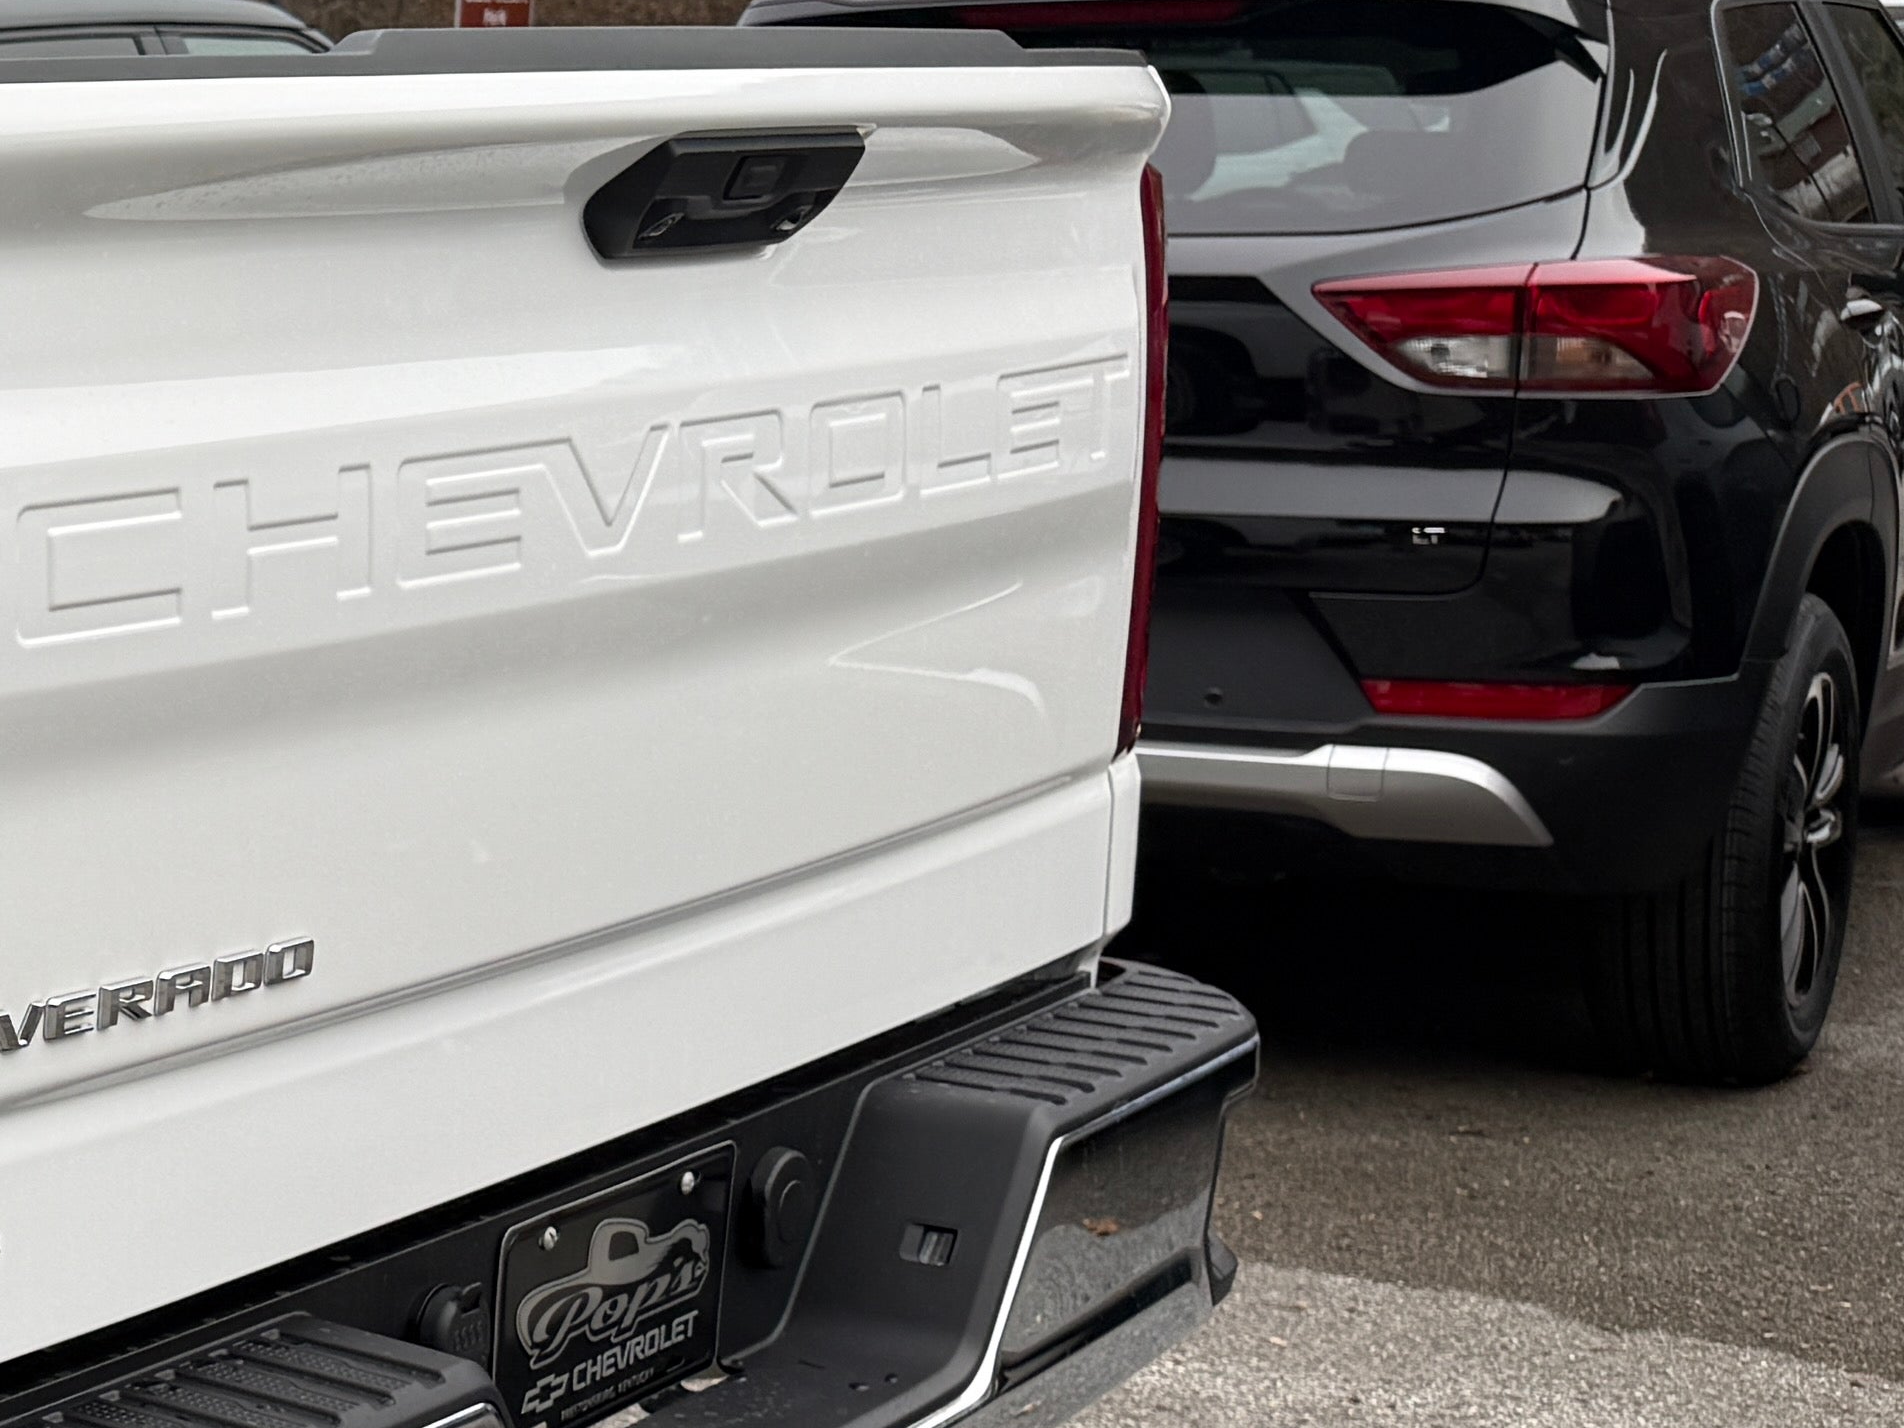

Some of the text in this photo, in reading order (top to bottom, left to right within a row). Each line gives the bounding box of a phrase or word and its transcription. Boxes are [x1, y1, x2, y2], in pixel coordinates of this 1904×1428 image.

[15, 352, 1132, 649] CHEVROLET
[1411, 526, 1446, 546] LT
[571, 1309, 699, 1392] CHEVROLET
